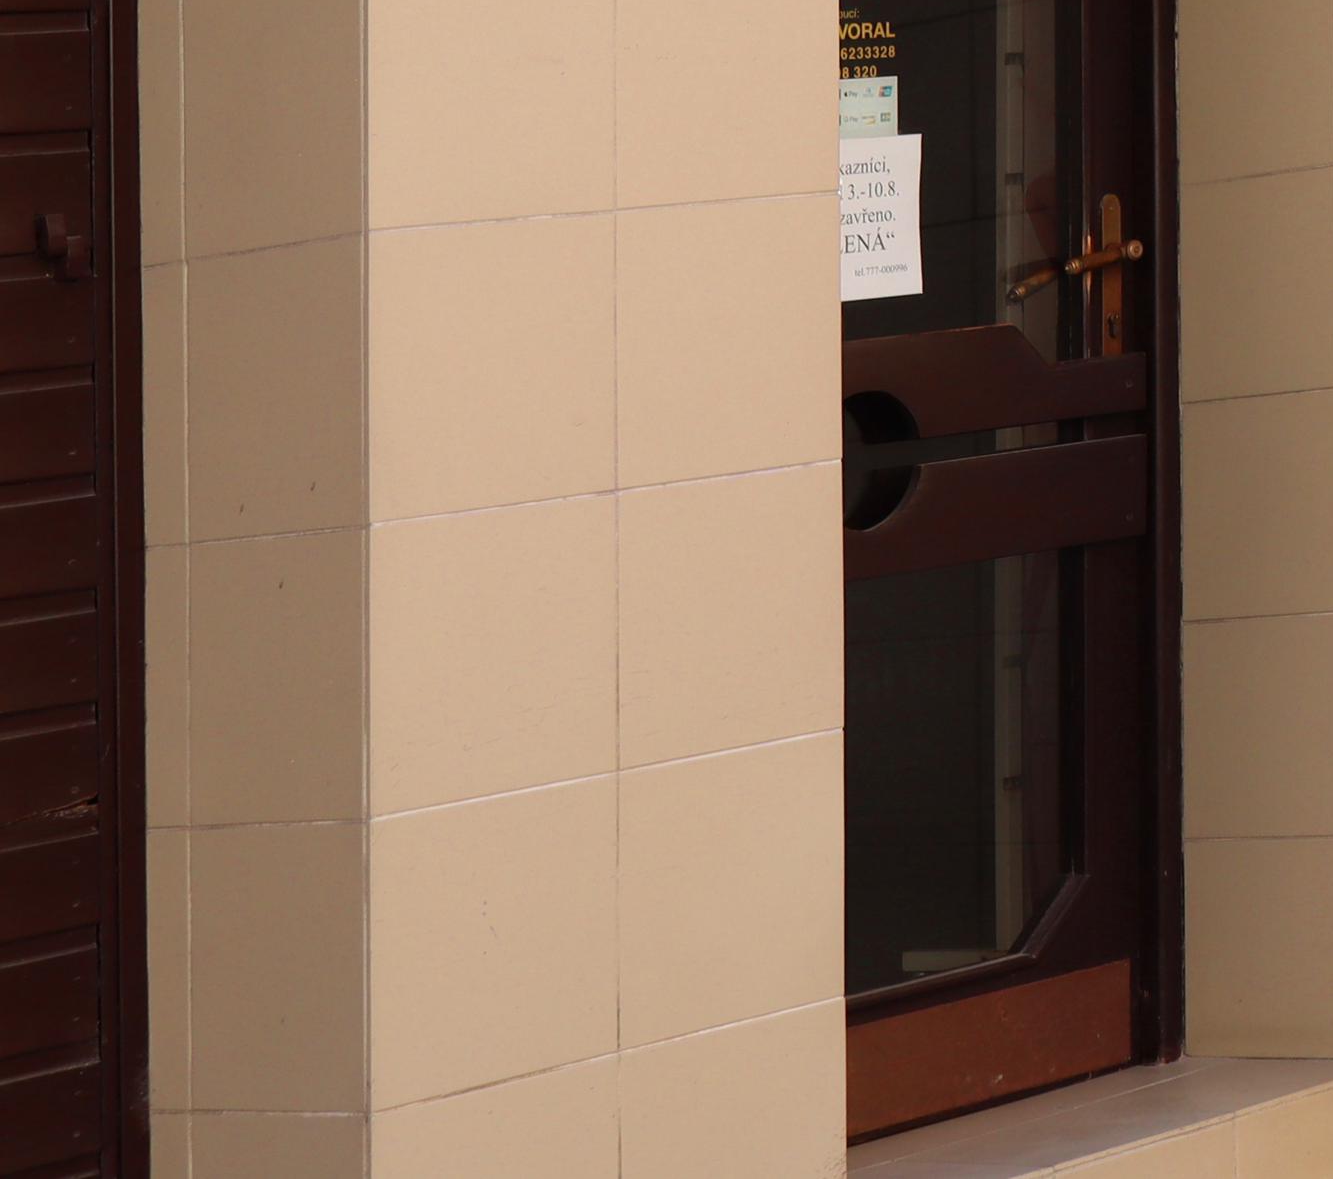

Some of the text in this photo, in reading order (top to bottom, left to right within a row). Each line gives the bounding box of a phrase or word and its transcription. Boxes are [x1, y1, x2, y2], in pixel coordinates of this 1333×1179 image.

[839, 21, 896, 40] VORAL
[840, 45, 896, 60] 6233328
[853, 65, 877, 79] 320
